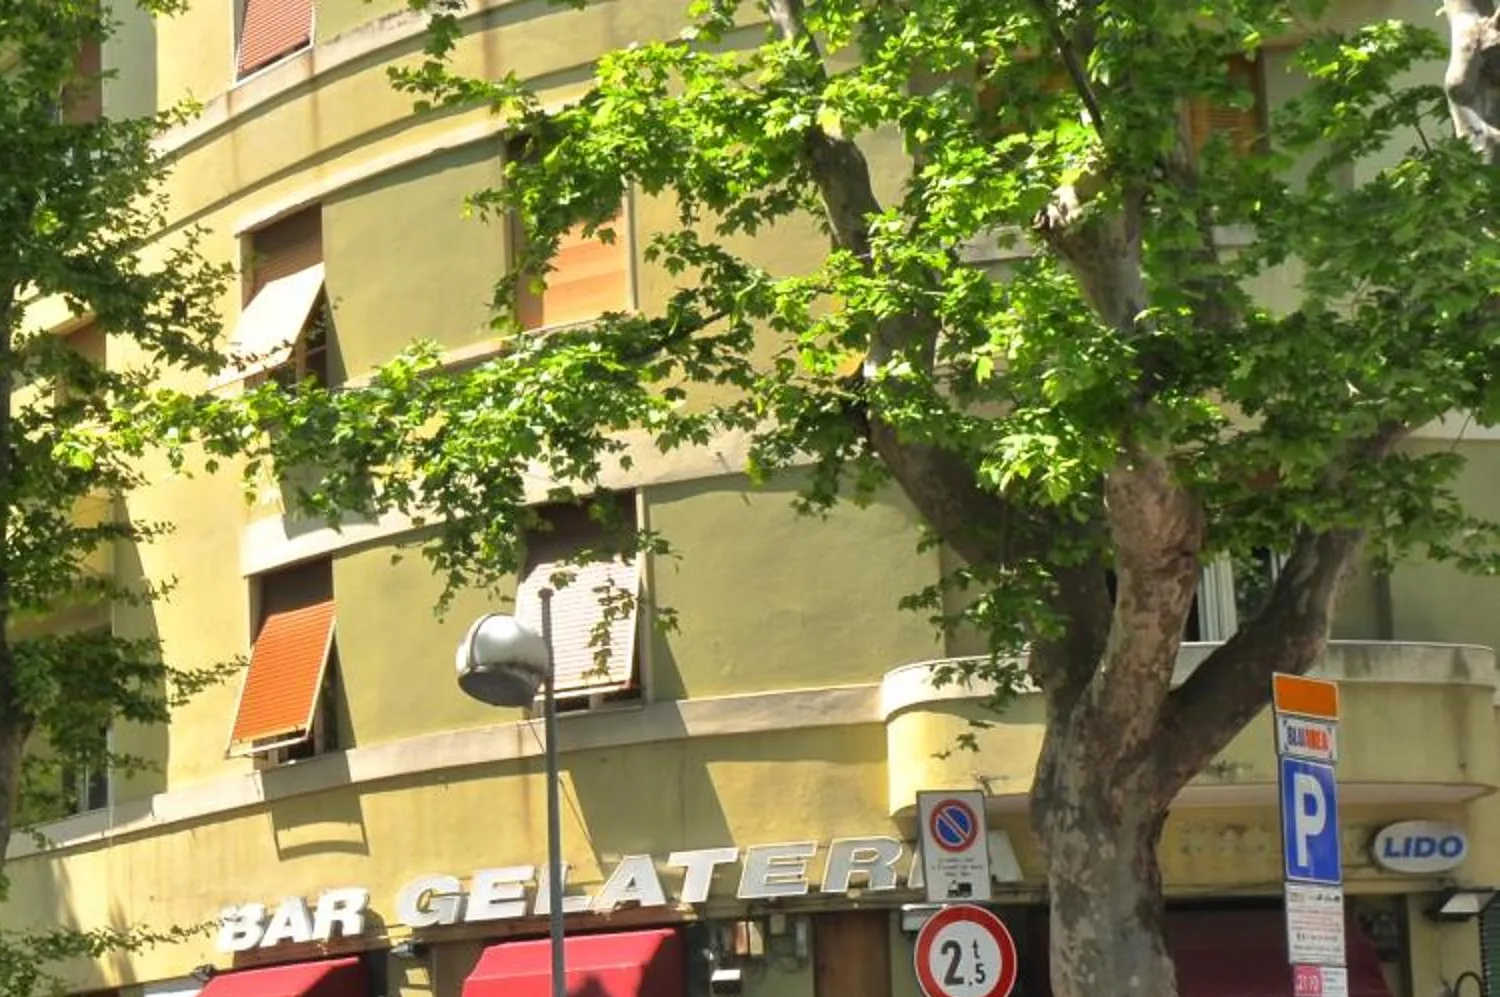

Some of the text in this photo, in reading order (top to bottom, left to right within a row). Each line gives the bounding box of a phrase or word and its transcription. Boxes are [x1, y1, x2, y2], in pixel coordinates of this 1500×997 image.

[1293, 772, 1327, 867] P
[1383, 834, 1464, 859] LIDO
[216, 886, 370, 951] BAR
